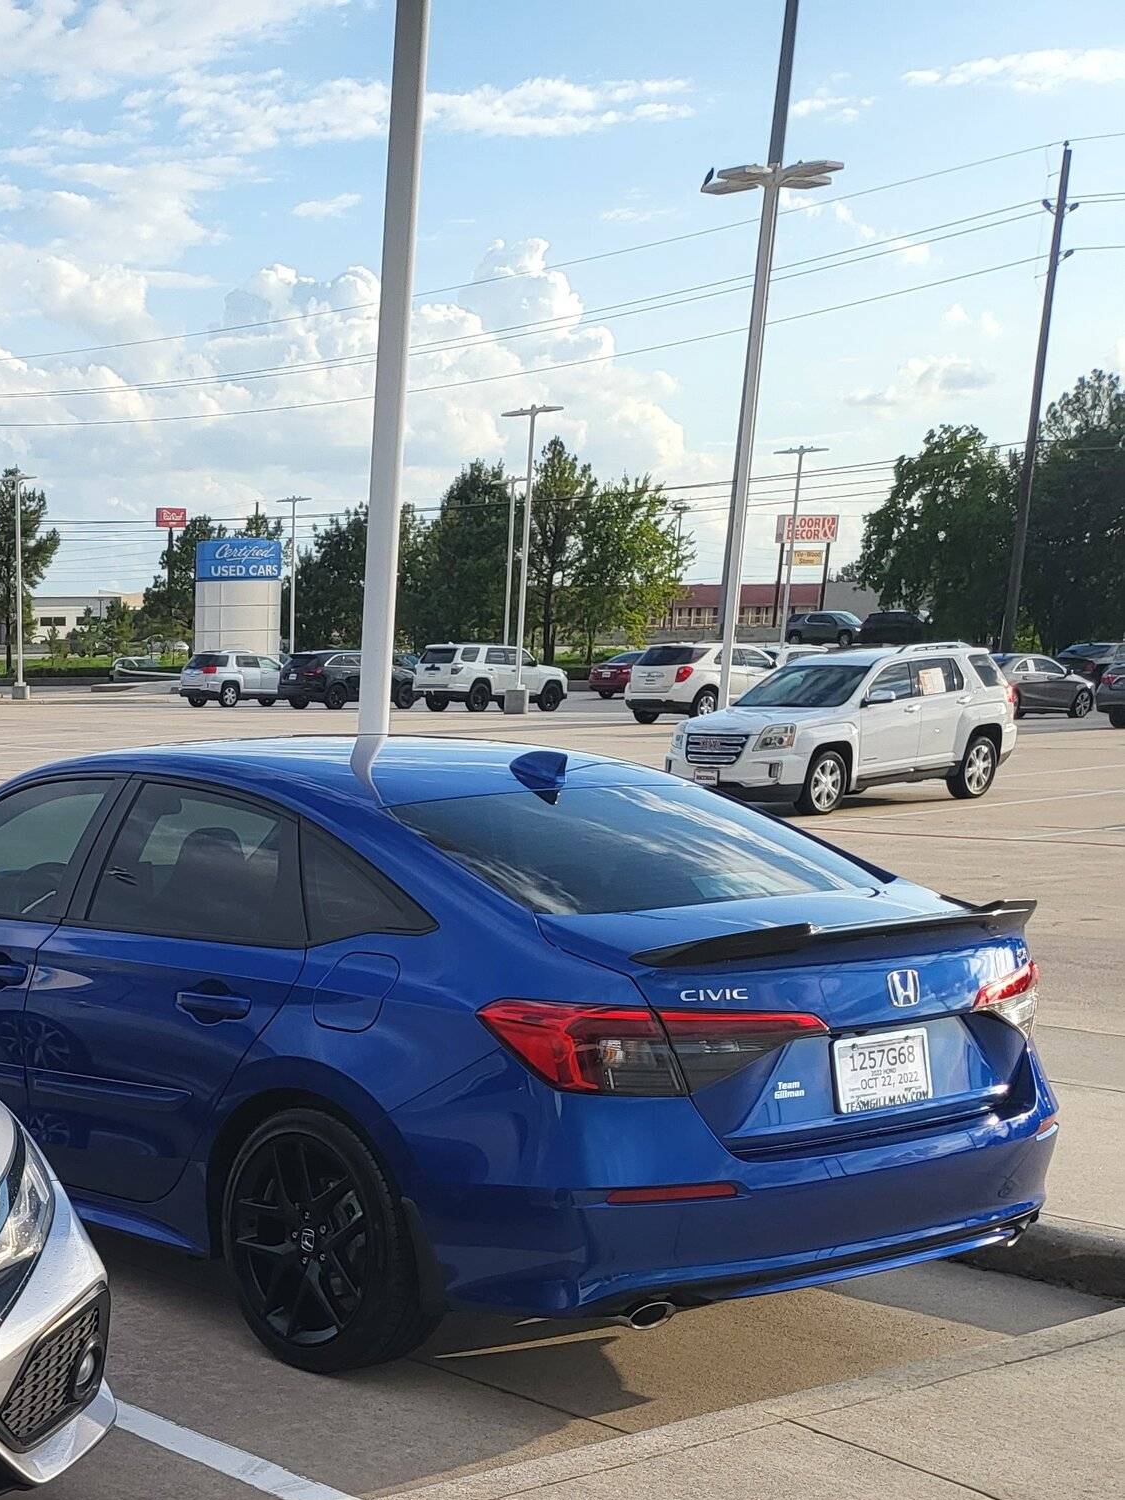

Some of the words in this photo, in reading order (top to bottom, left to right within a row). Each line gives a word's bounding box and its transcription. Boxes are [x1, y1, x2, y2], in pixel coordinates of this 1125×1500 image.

[787, 517, 821, 528] FOOR
[786, 529, 820, 540] DECOR
[215, 544, 275, 562] Certified
[211, 565, 245, 576] USED
[249, 565, 278, 576] CARS
[679, 988, 749, 1002] CIVIC
[849, 1045, 916, 1072] 1257G68
[777, 1081, 801, 1091] Team
[860, 1077, 878, 1090] OCT
[881, 1075, 895, 1088] 22,
[897, 1070, 920, 1085] 2022
[774, 1089, 805, 1100] Gillman
[845, 1089, 929, 1113] TEAMGILLMAN.COM
